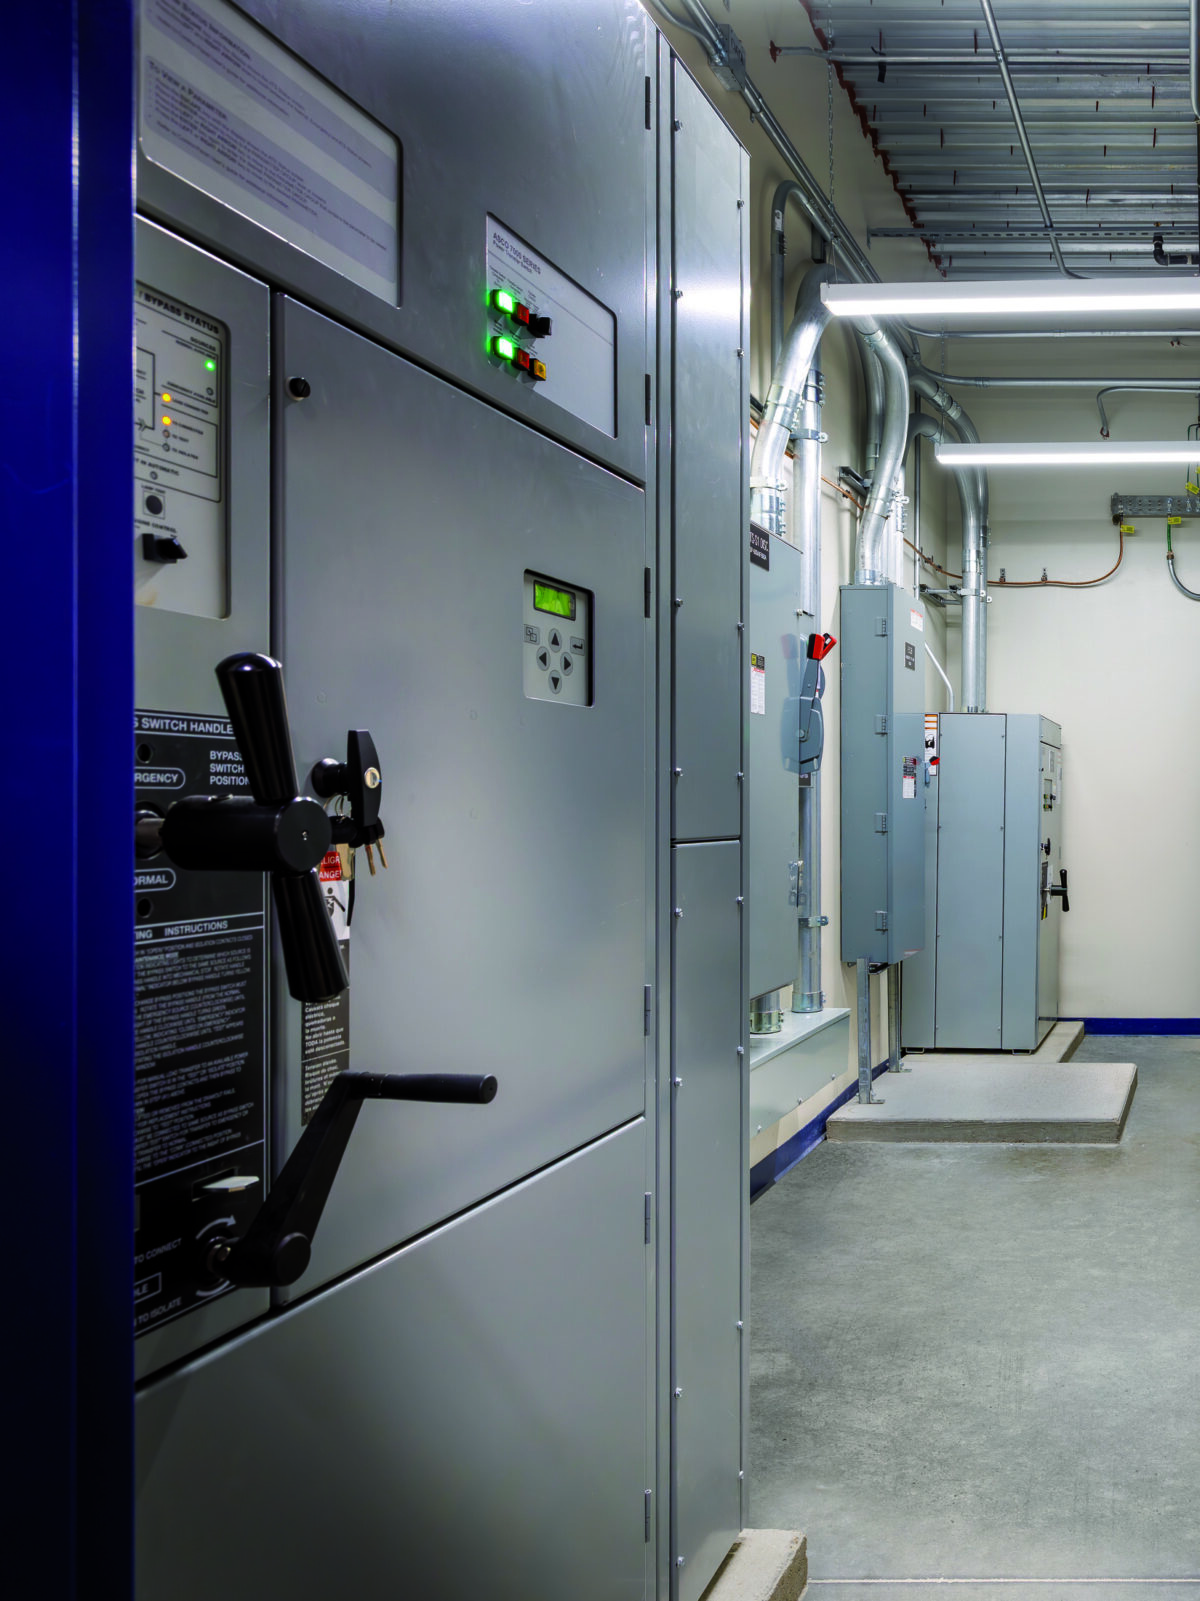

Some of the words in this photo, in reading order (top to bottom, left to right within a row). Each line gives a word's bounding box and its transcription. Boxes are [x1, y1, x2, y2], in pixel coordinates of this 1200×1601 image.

[144, 292, 181, 318] BYPASS
[183, 310, 219, 335] STATUS
[141, 717, 187, 731] SWITCH
[190, 721, 234, 734] HANDLE
[209, 750, 243, 761] BYPAS
[209, 763, 245, 773] SWITCH
[134, 772, 179, 783] RGENCY
[319, 870, 342, 879] ANGE
[164, 920, 228, 936] INSTRUCTIONS
[146, 1237, 182, 1260] CONNECT
[138, 1313, 150, 1324] TO
[150, 1296, 182, 1319] ISOLATE
